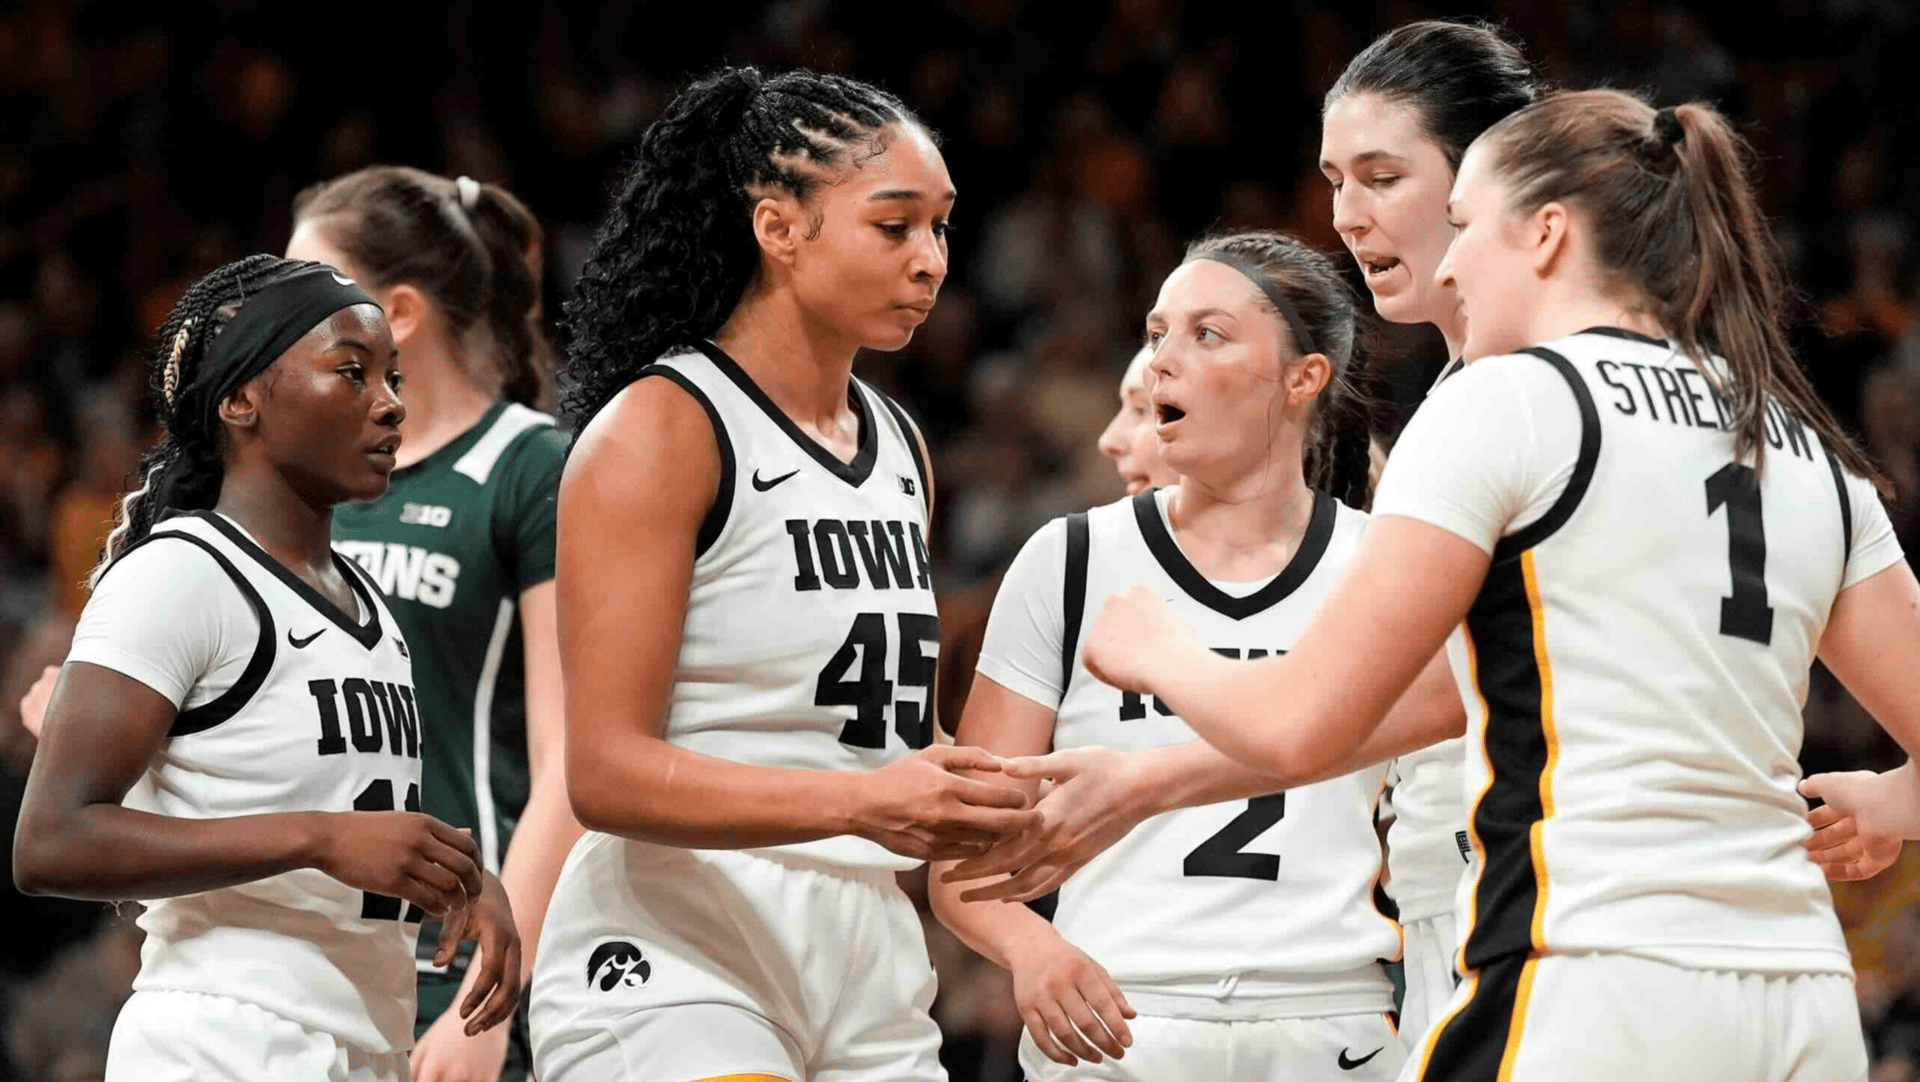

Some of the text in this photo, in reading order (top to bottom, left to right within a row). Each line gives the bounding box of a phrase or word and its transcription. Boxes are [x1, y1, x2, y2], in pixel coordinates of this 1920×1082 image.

[1704, 462, 1774, 647] 1
[308, 678, 424, 759] IOW
[814, 612, 940, 751] 45
[1183, 791, 1286, 881] 2
